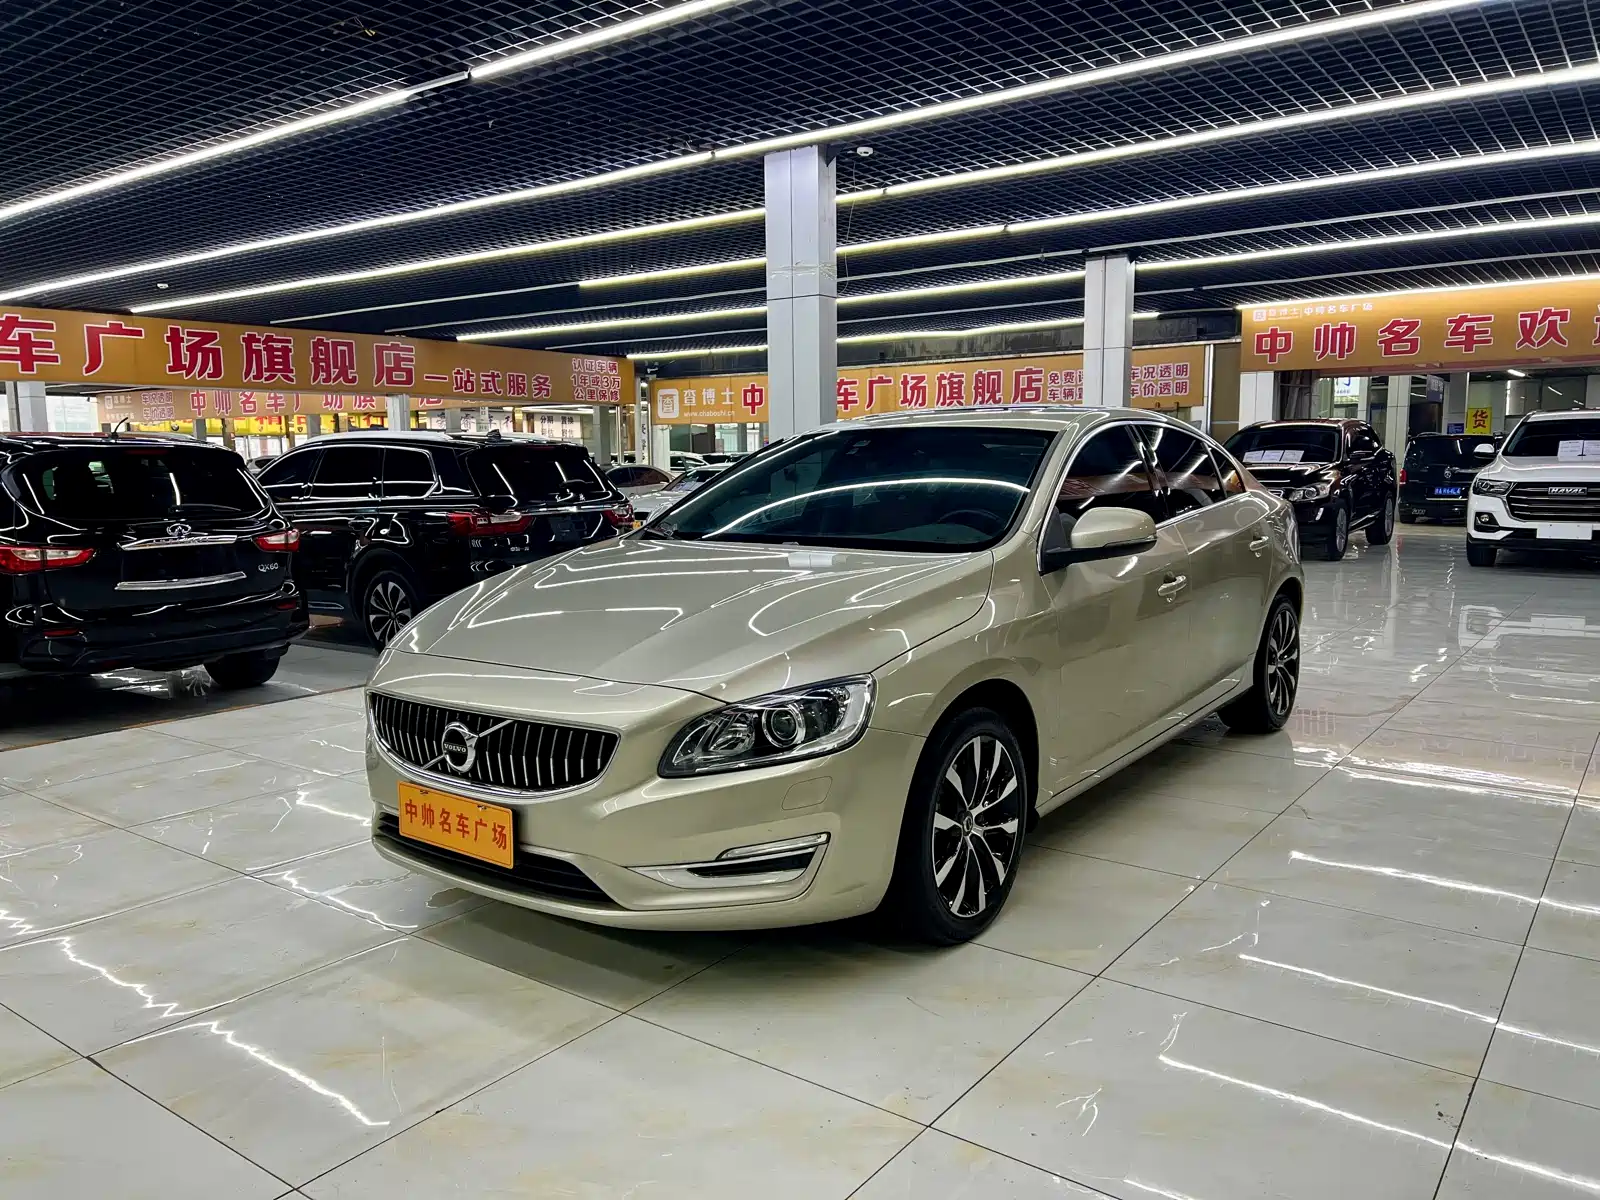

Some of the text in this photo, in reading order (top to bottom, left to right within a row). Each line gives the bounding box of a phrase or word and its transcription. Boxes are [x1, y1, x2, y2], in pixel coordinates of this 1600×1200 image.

[1254, 304, 1600, 364] 中帅名车欢
[0, 313, 552, 398] 车广场旗舰店 一站式服务
[572, 358, 618, 374] 认证车辆
[1131, 363, 1189, 380] 车况透明
[571, 374, 621, 389] 1年或3万
[1047, 370, 1083, 386] 免费
[574, 387, 620, 402] 公里保修
[683, 387, 735, 406] 查博士
[742, 367, 1044, 416] 中车广场旗舰店
[1047, 386, 1083, 401] 车辆
[1131, 380, 1189, 398] 车价透明
[683, 410, 735, 418] www.chaboshi.cn
[1551, 487, 1586, 495] HAVAL
[258, 563, 279, 572] QX60
[444, 743, 466, 753] VOLVO
[404, 799, 507, 850] 中帅名车广场
